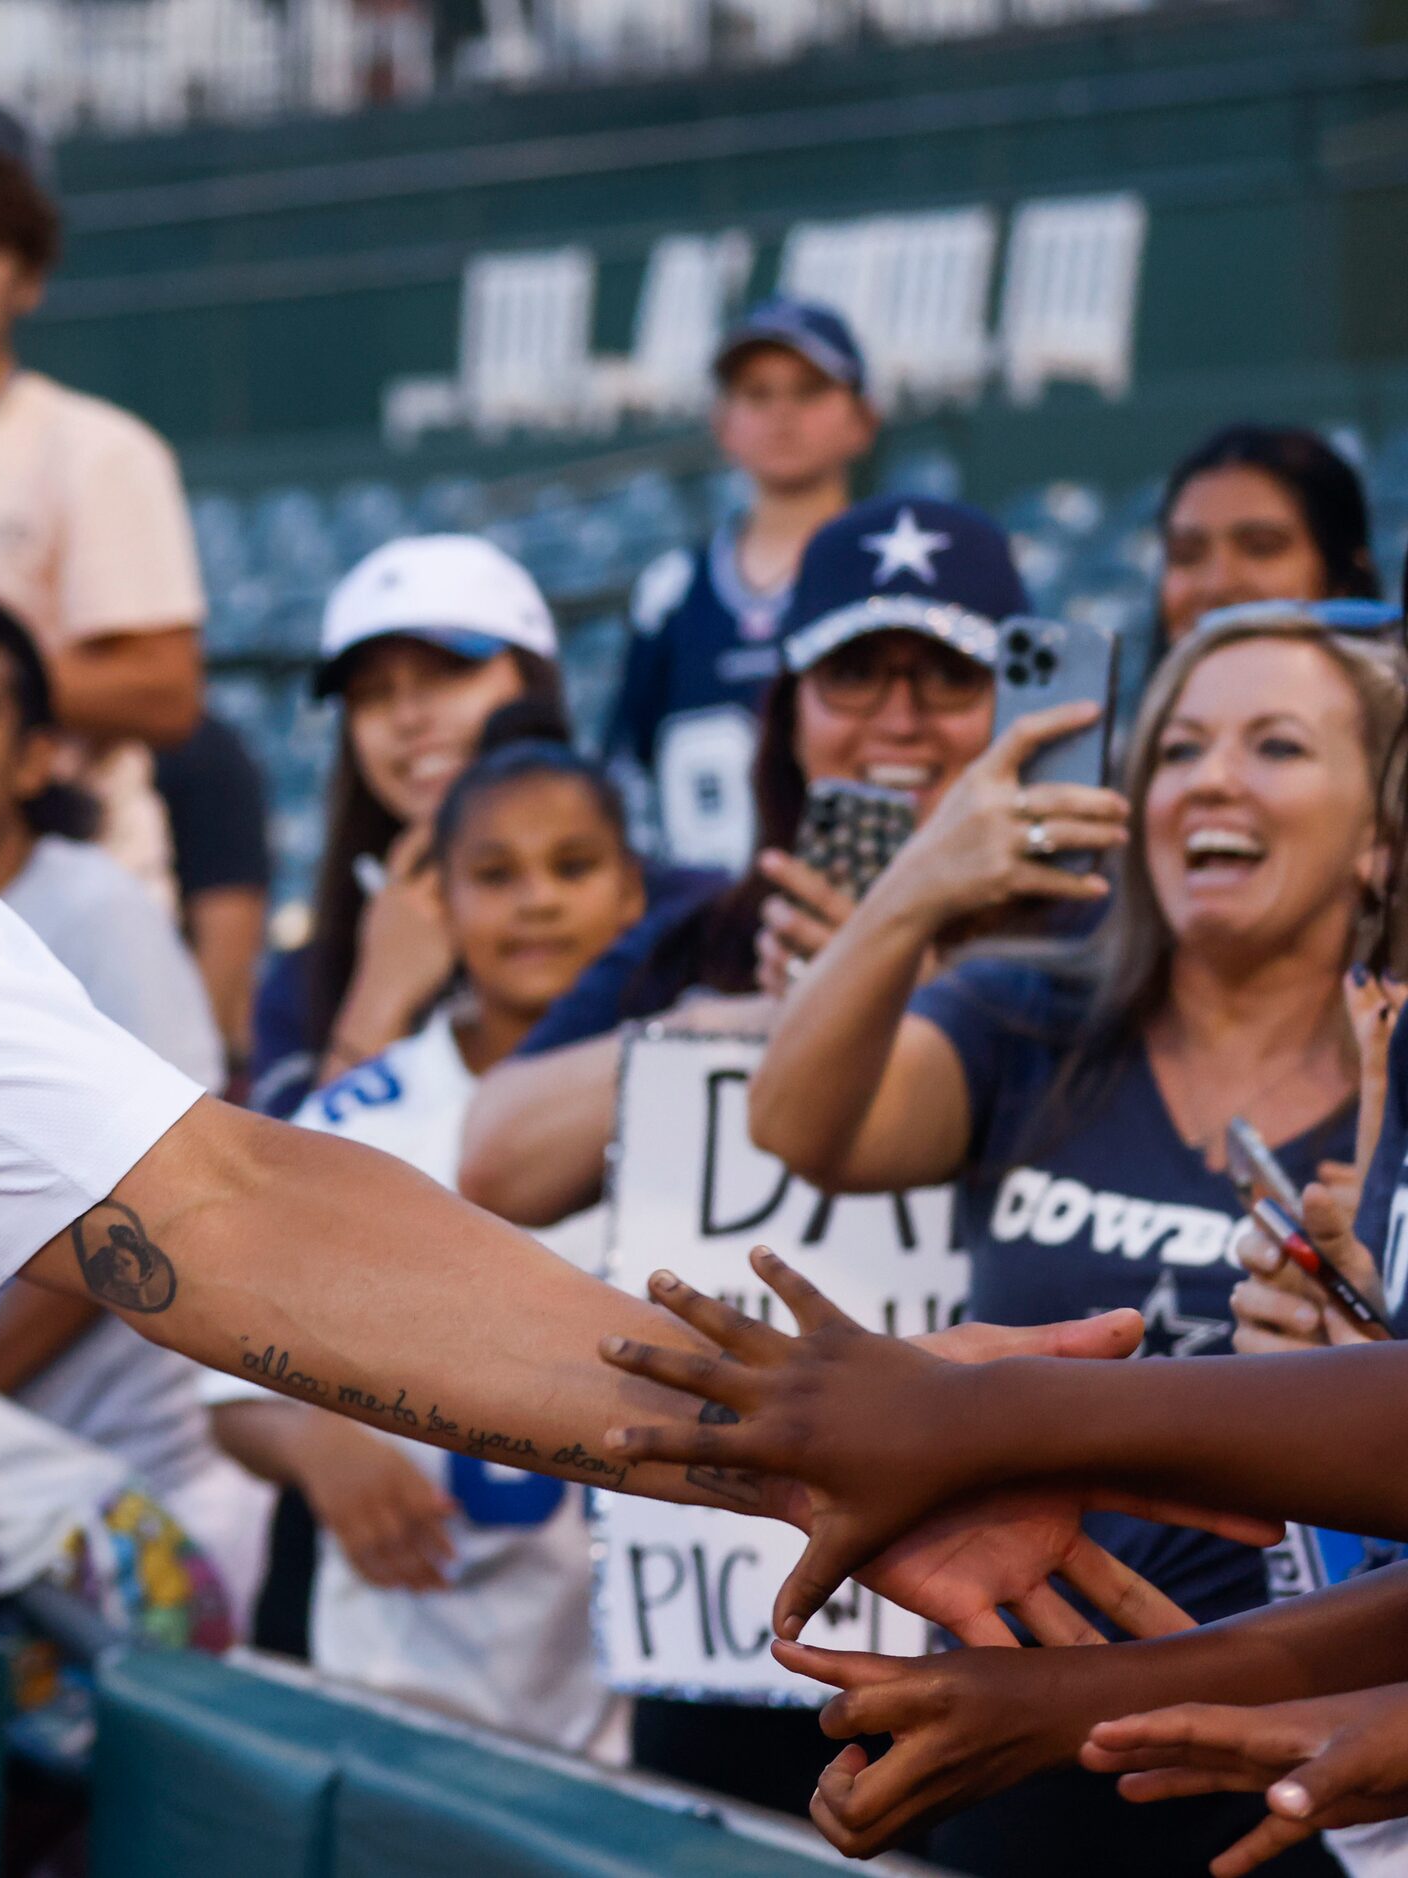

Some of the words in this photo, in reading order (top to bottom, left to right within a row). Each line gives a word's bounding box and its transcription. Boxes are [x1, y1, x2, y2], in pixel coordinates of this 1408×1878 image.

[337, 1385, 385, 1413] me
[386, 1389, 418, 1426] to
[426, 1404, 459, 1437] be
[465, 1427, 538, 1457] your
